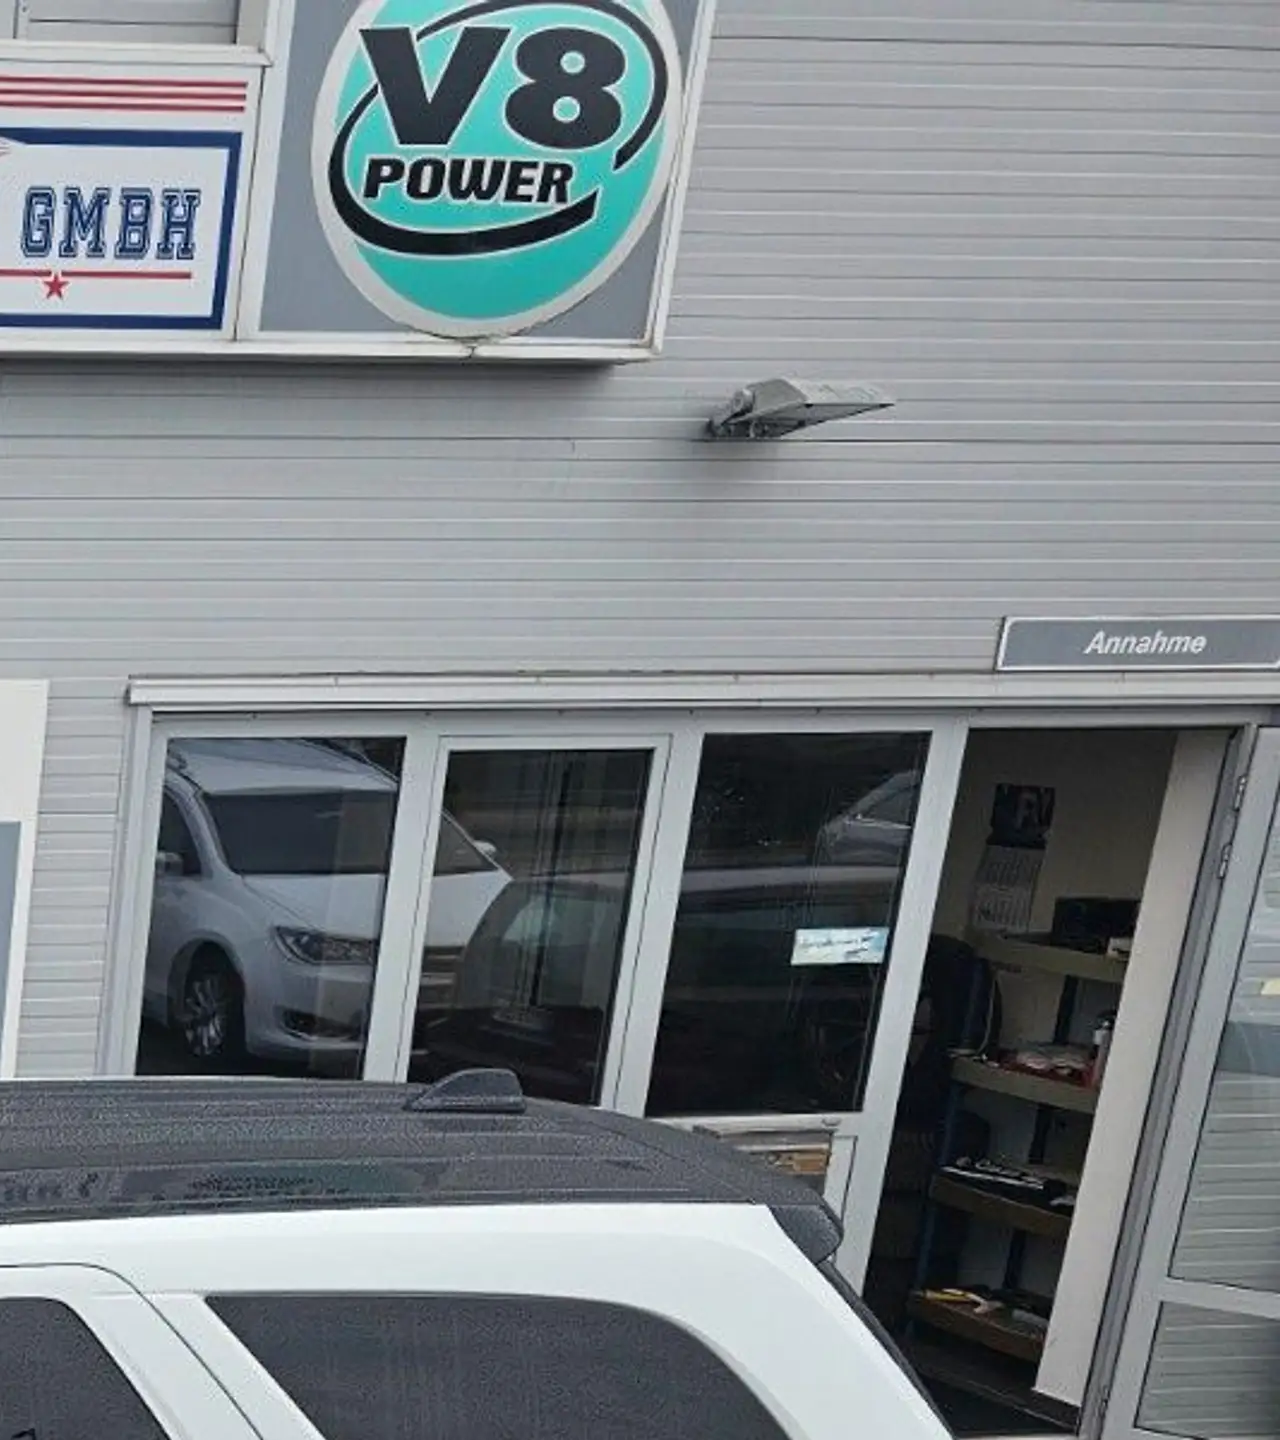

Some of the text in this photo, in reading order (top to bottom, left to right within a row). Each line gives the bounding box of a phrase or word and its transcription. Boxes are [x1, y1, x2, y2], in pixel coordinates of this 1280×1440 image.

[358, 25, 627, 151] V8
[362, 157, 576, 204] POWER
[21, 185, 202, 261] GMBH
[1082, 629, 1208, 655] Annahme
